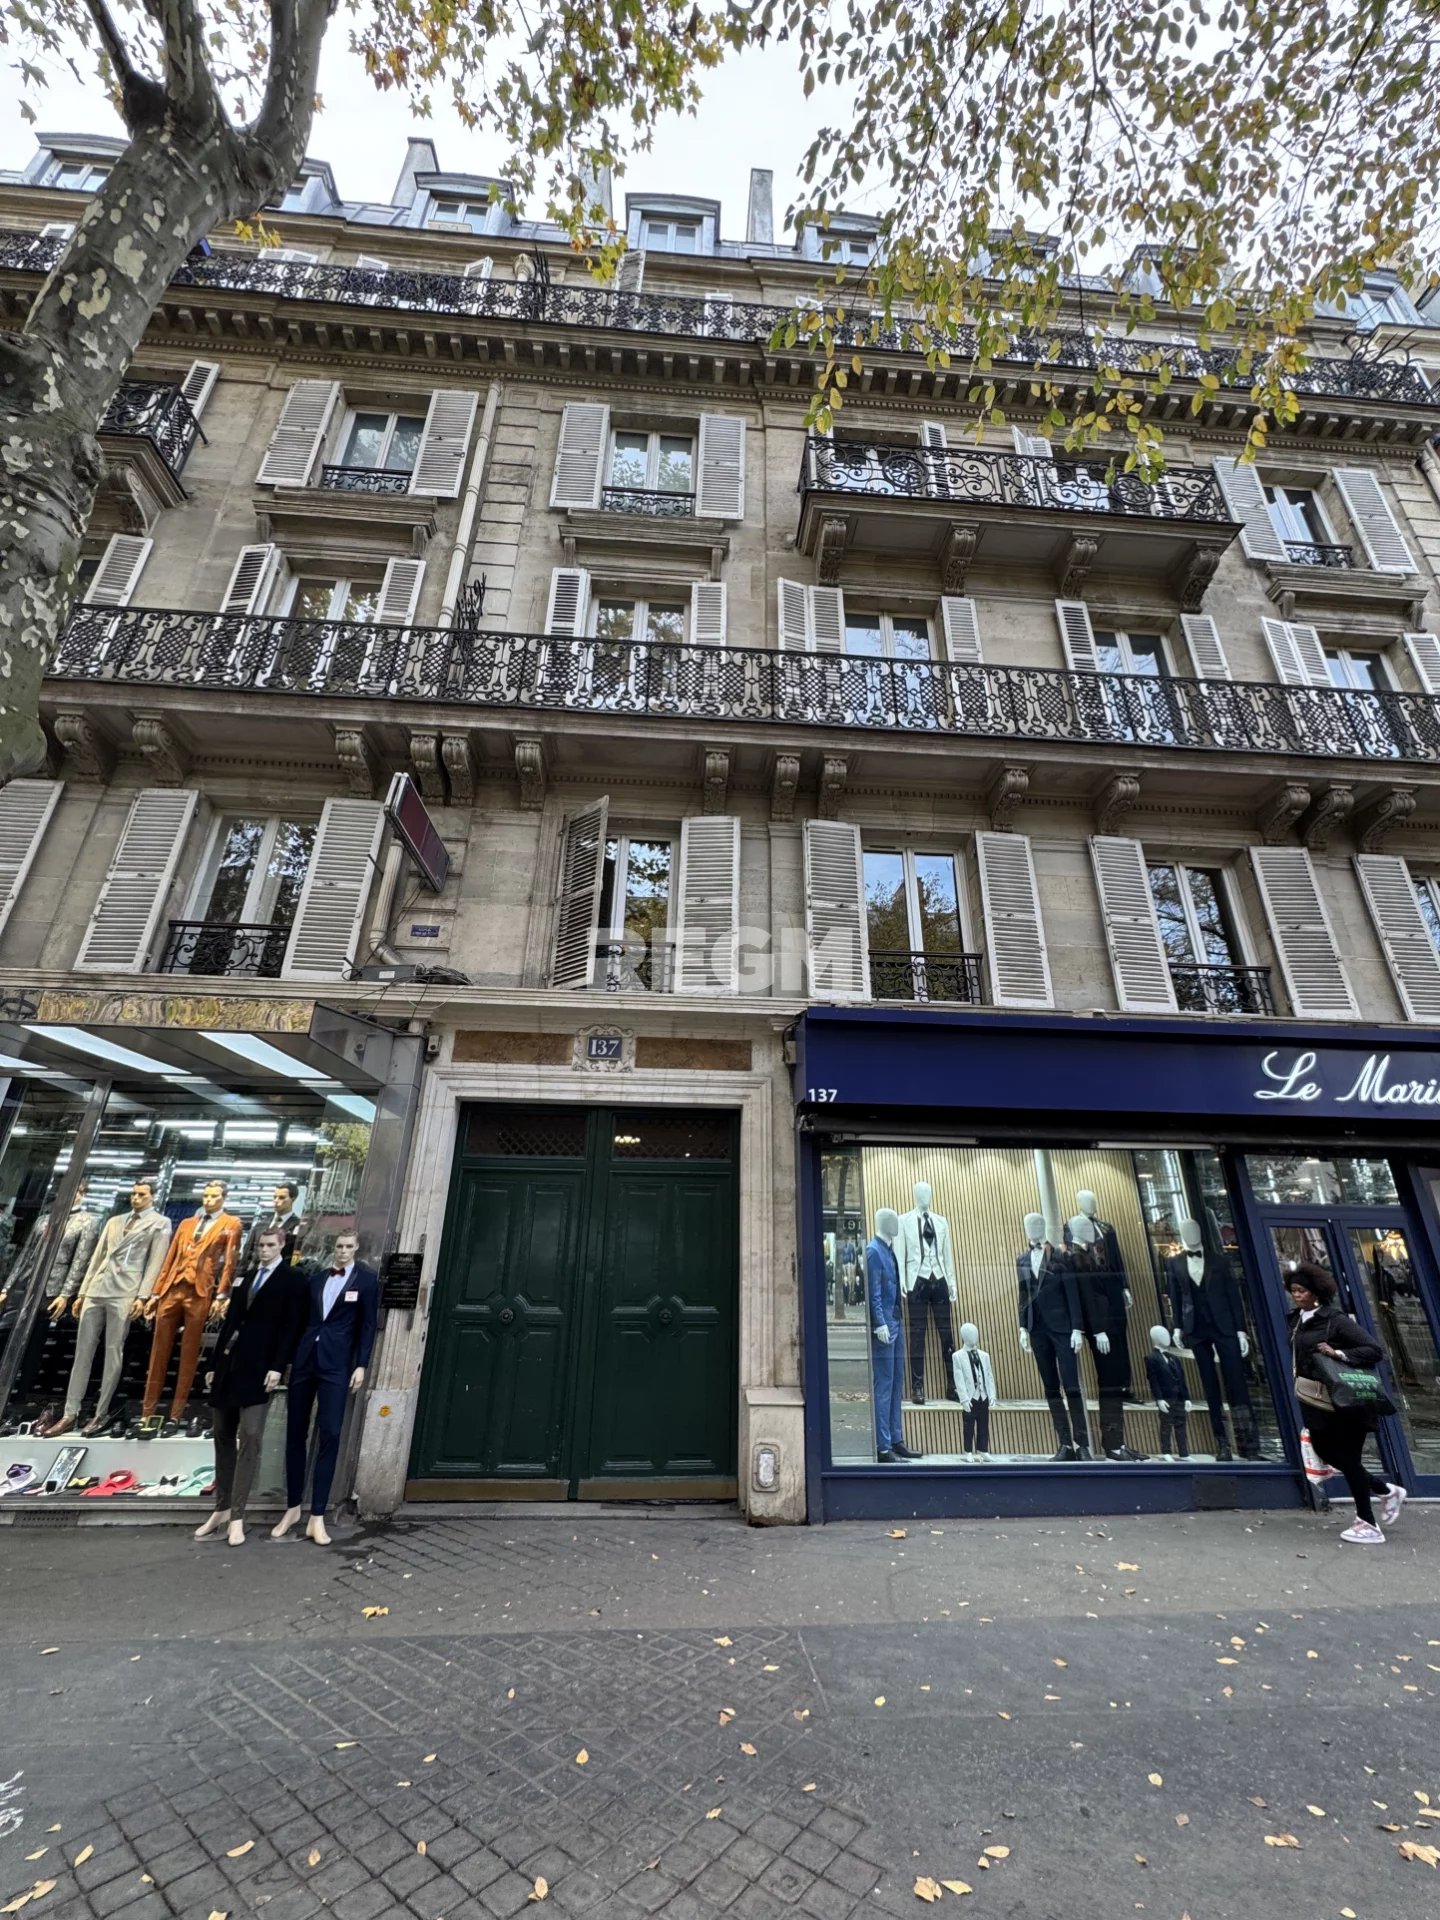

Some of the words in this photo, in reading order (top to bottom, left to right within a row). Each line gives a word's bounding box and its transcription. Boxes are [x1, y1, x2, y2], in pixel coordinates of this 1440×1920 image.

[591, 1039, 619, 1055] 137
[1253, 1051, 1322, 1100] Le
[1335, 1054, 1440, 1104] Mari
[808, 1088, 838, 1102] 137
